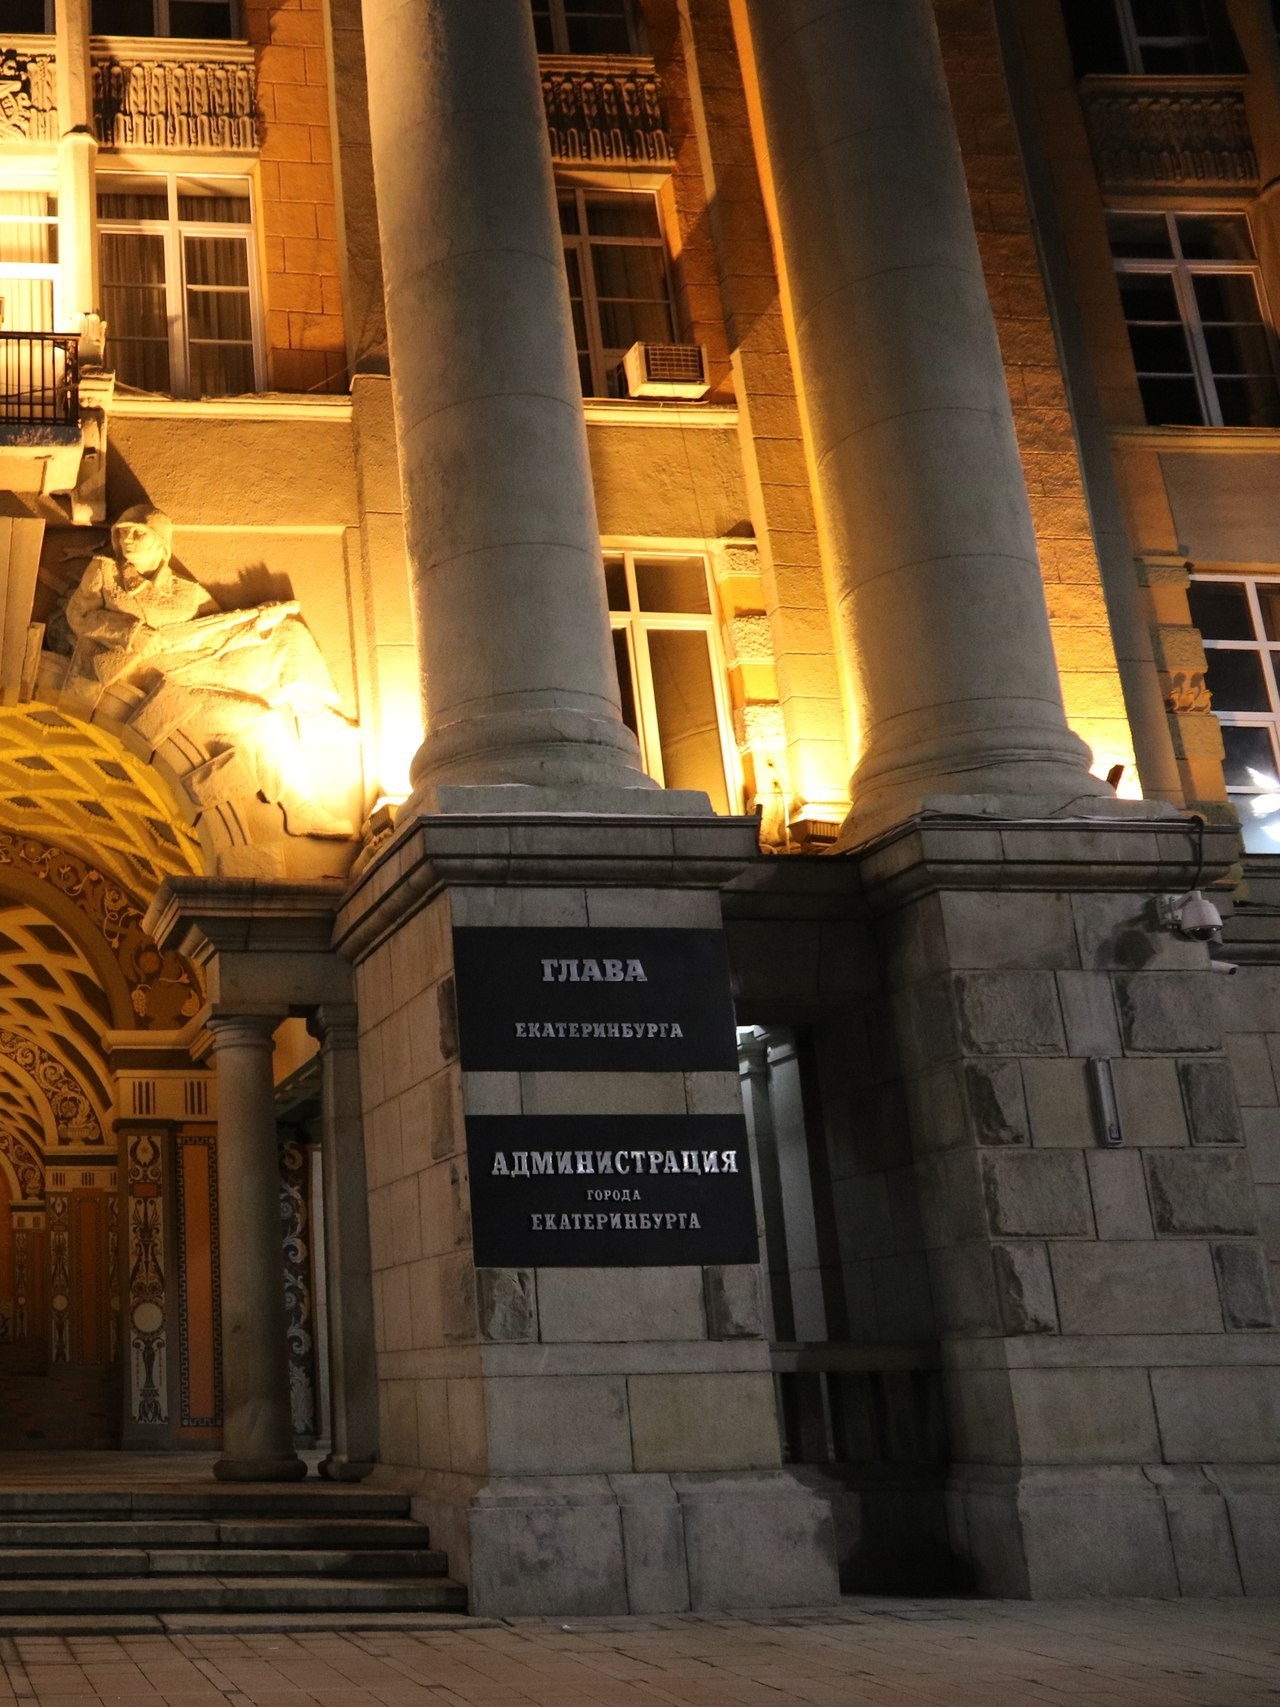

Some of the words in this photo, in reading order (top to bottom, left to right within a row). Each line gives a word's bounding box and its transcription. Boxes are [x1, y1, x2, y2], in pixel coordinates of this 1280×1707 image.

[540, 958, 648, 983] ГЛАВА
[515, 1022, 684, 1039] ЕКАТЕРИНБУРГА
[491, 1149, 739, 1178] АДМИНИСТРАЦИЯ
[586, 1189, 642, 1202] ГОРОДА
[530, 1212, 702, 1231] ЕКАТЕРИНБУРГА
